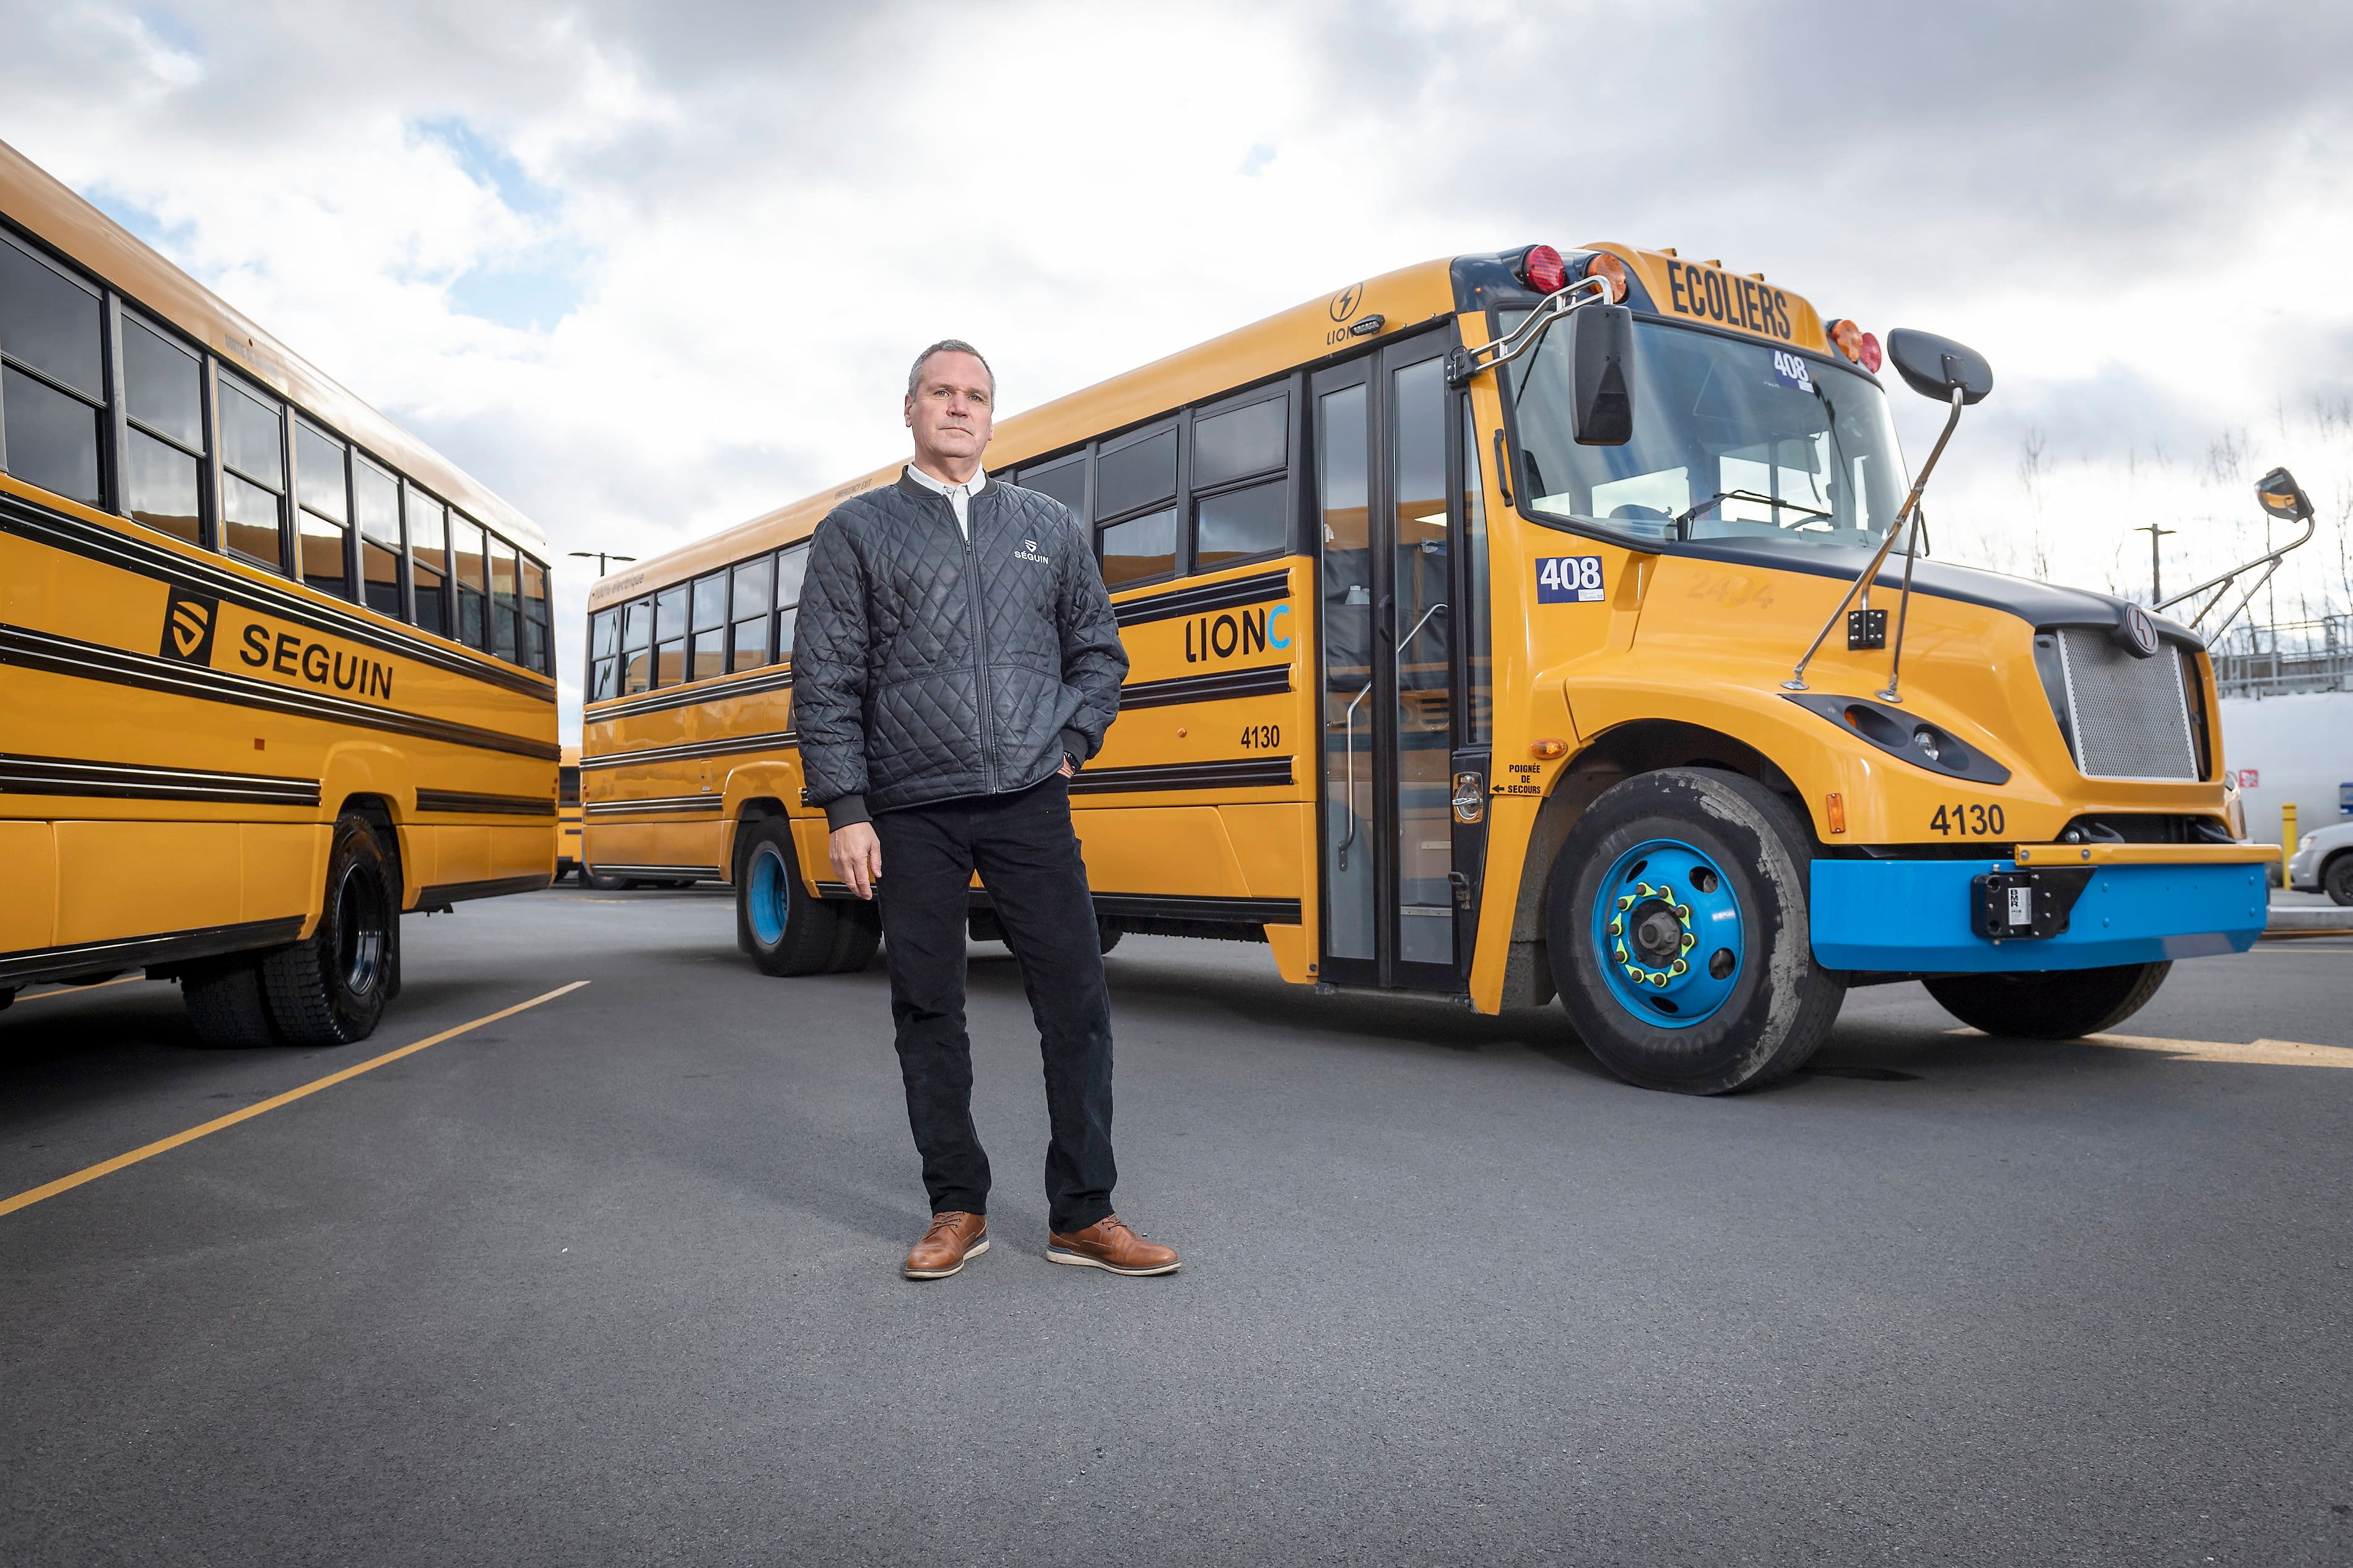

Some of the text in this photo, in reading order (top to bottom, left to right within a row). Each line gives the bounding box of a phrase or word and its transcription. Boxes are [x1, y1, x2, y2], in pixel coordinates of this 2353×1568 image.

[1667, 259, 1791, 339] ECOLIERS
[1774, 350, 1809, 382] 408
[1014, 550, 1049, 565] SÉGUIN
[1540, 557, 1601, 590] 408
[239, 624, 393, 700] SEGUIN
[1240, 724, 1280, 749] 4130
[1509, 763, 1541, 773] POIGNÉE
[1521, 775, 1531, 783] DE
[1508, 785, 1541, 794] SECOURS
[1930, 804, 2005, 836] 4130
